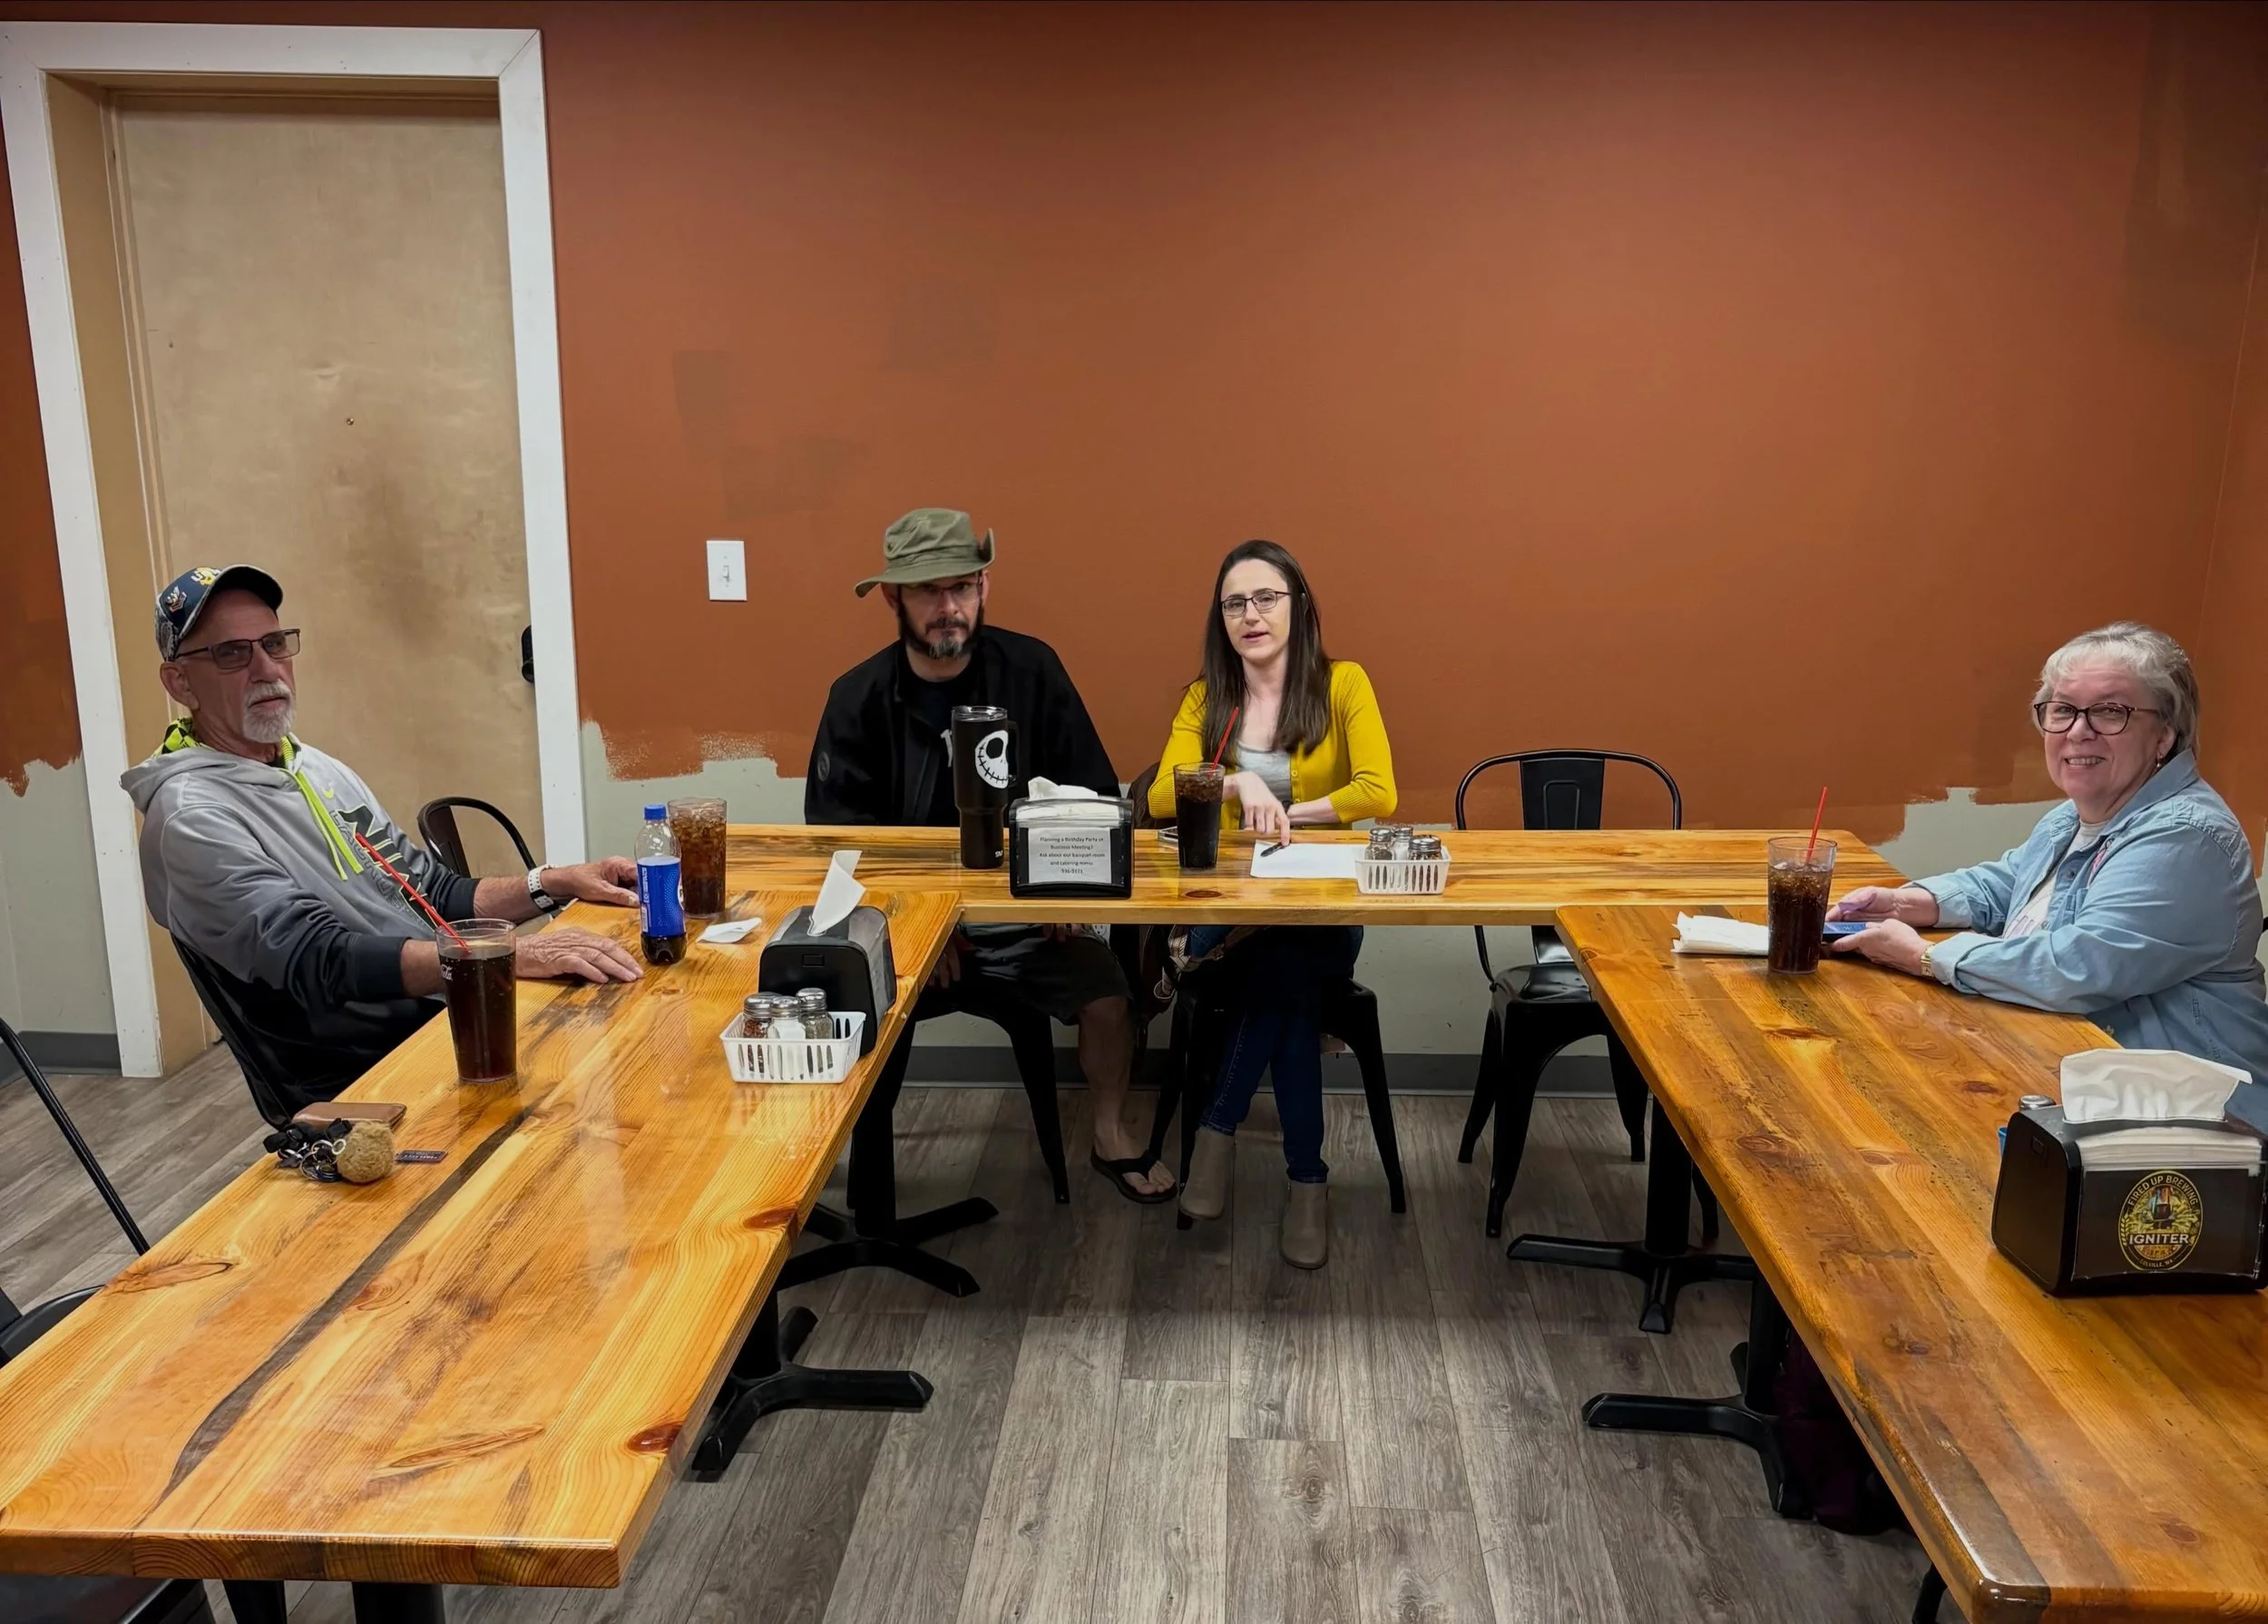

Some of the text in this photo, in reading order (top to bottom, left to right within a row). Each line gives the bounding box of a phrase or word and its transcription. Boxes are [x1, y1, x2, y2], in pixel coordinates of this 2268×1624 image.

[2127, 1174, 2198, 1206] FIRED UP BREWING
[2129, 1234, 2189, 1245] IGNITER
